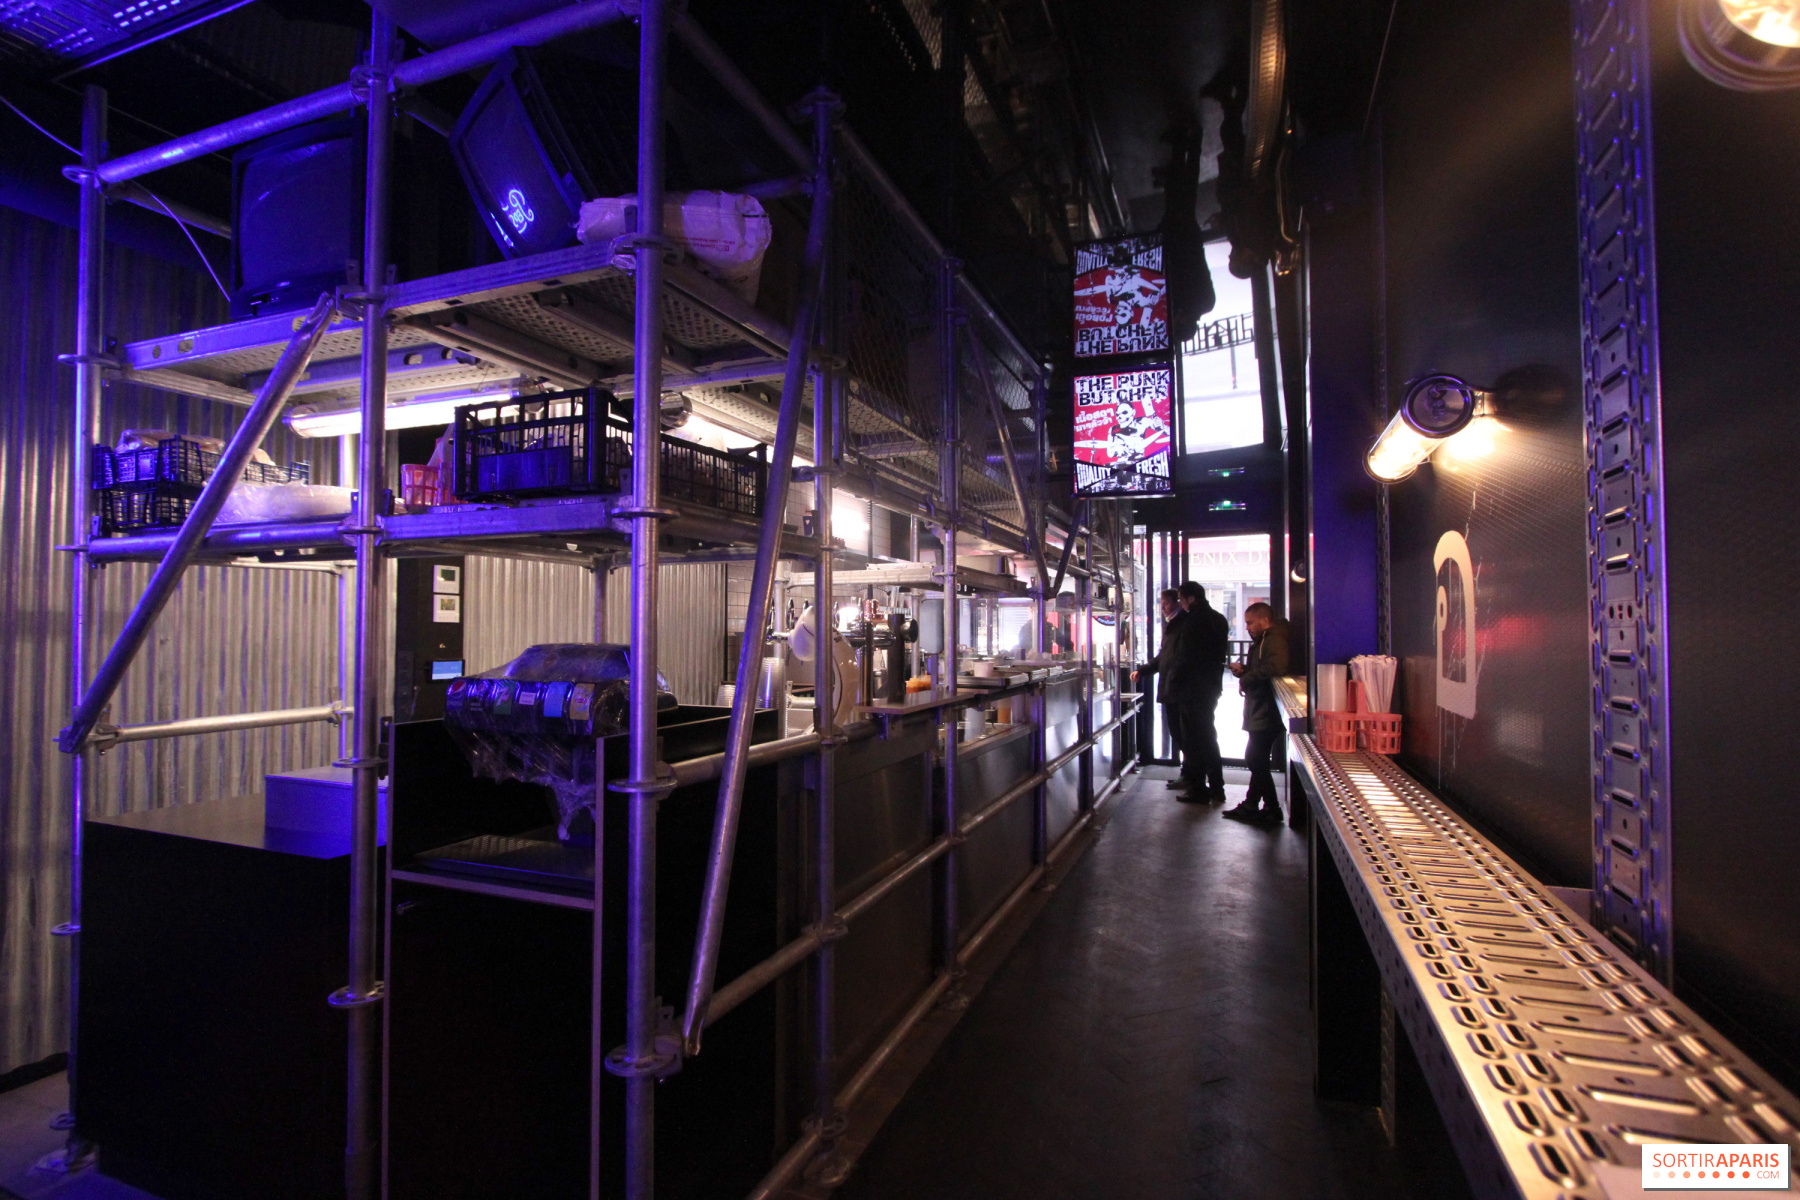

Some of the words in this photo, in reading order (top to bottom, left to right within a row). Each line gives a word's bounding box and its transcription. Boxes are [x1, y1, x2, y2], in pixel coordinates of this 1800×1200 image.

[1076, 376, 1112, 392] THE
[1117, 370, 1170, 389] PUNK
[1079, 385, 1167, 406] BUTCHER
[1076, 462, 1112, 489] QUALITY
[1136, 450, 1170, 478] FRESH
